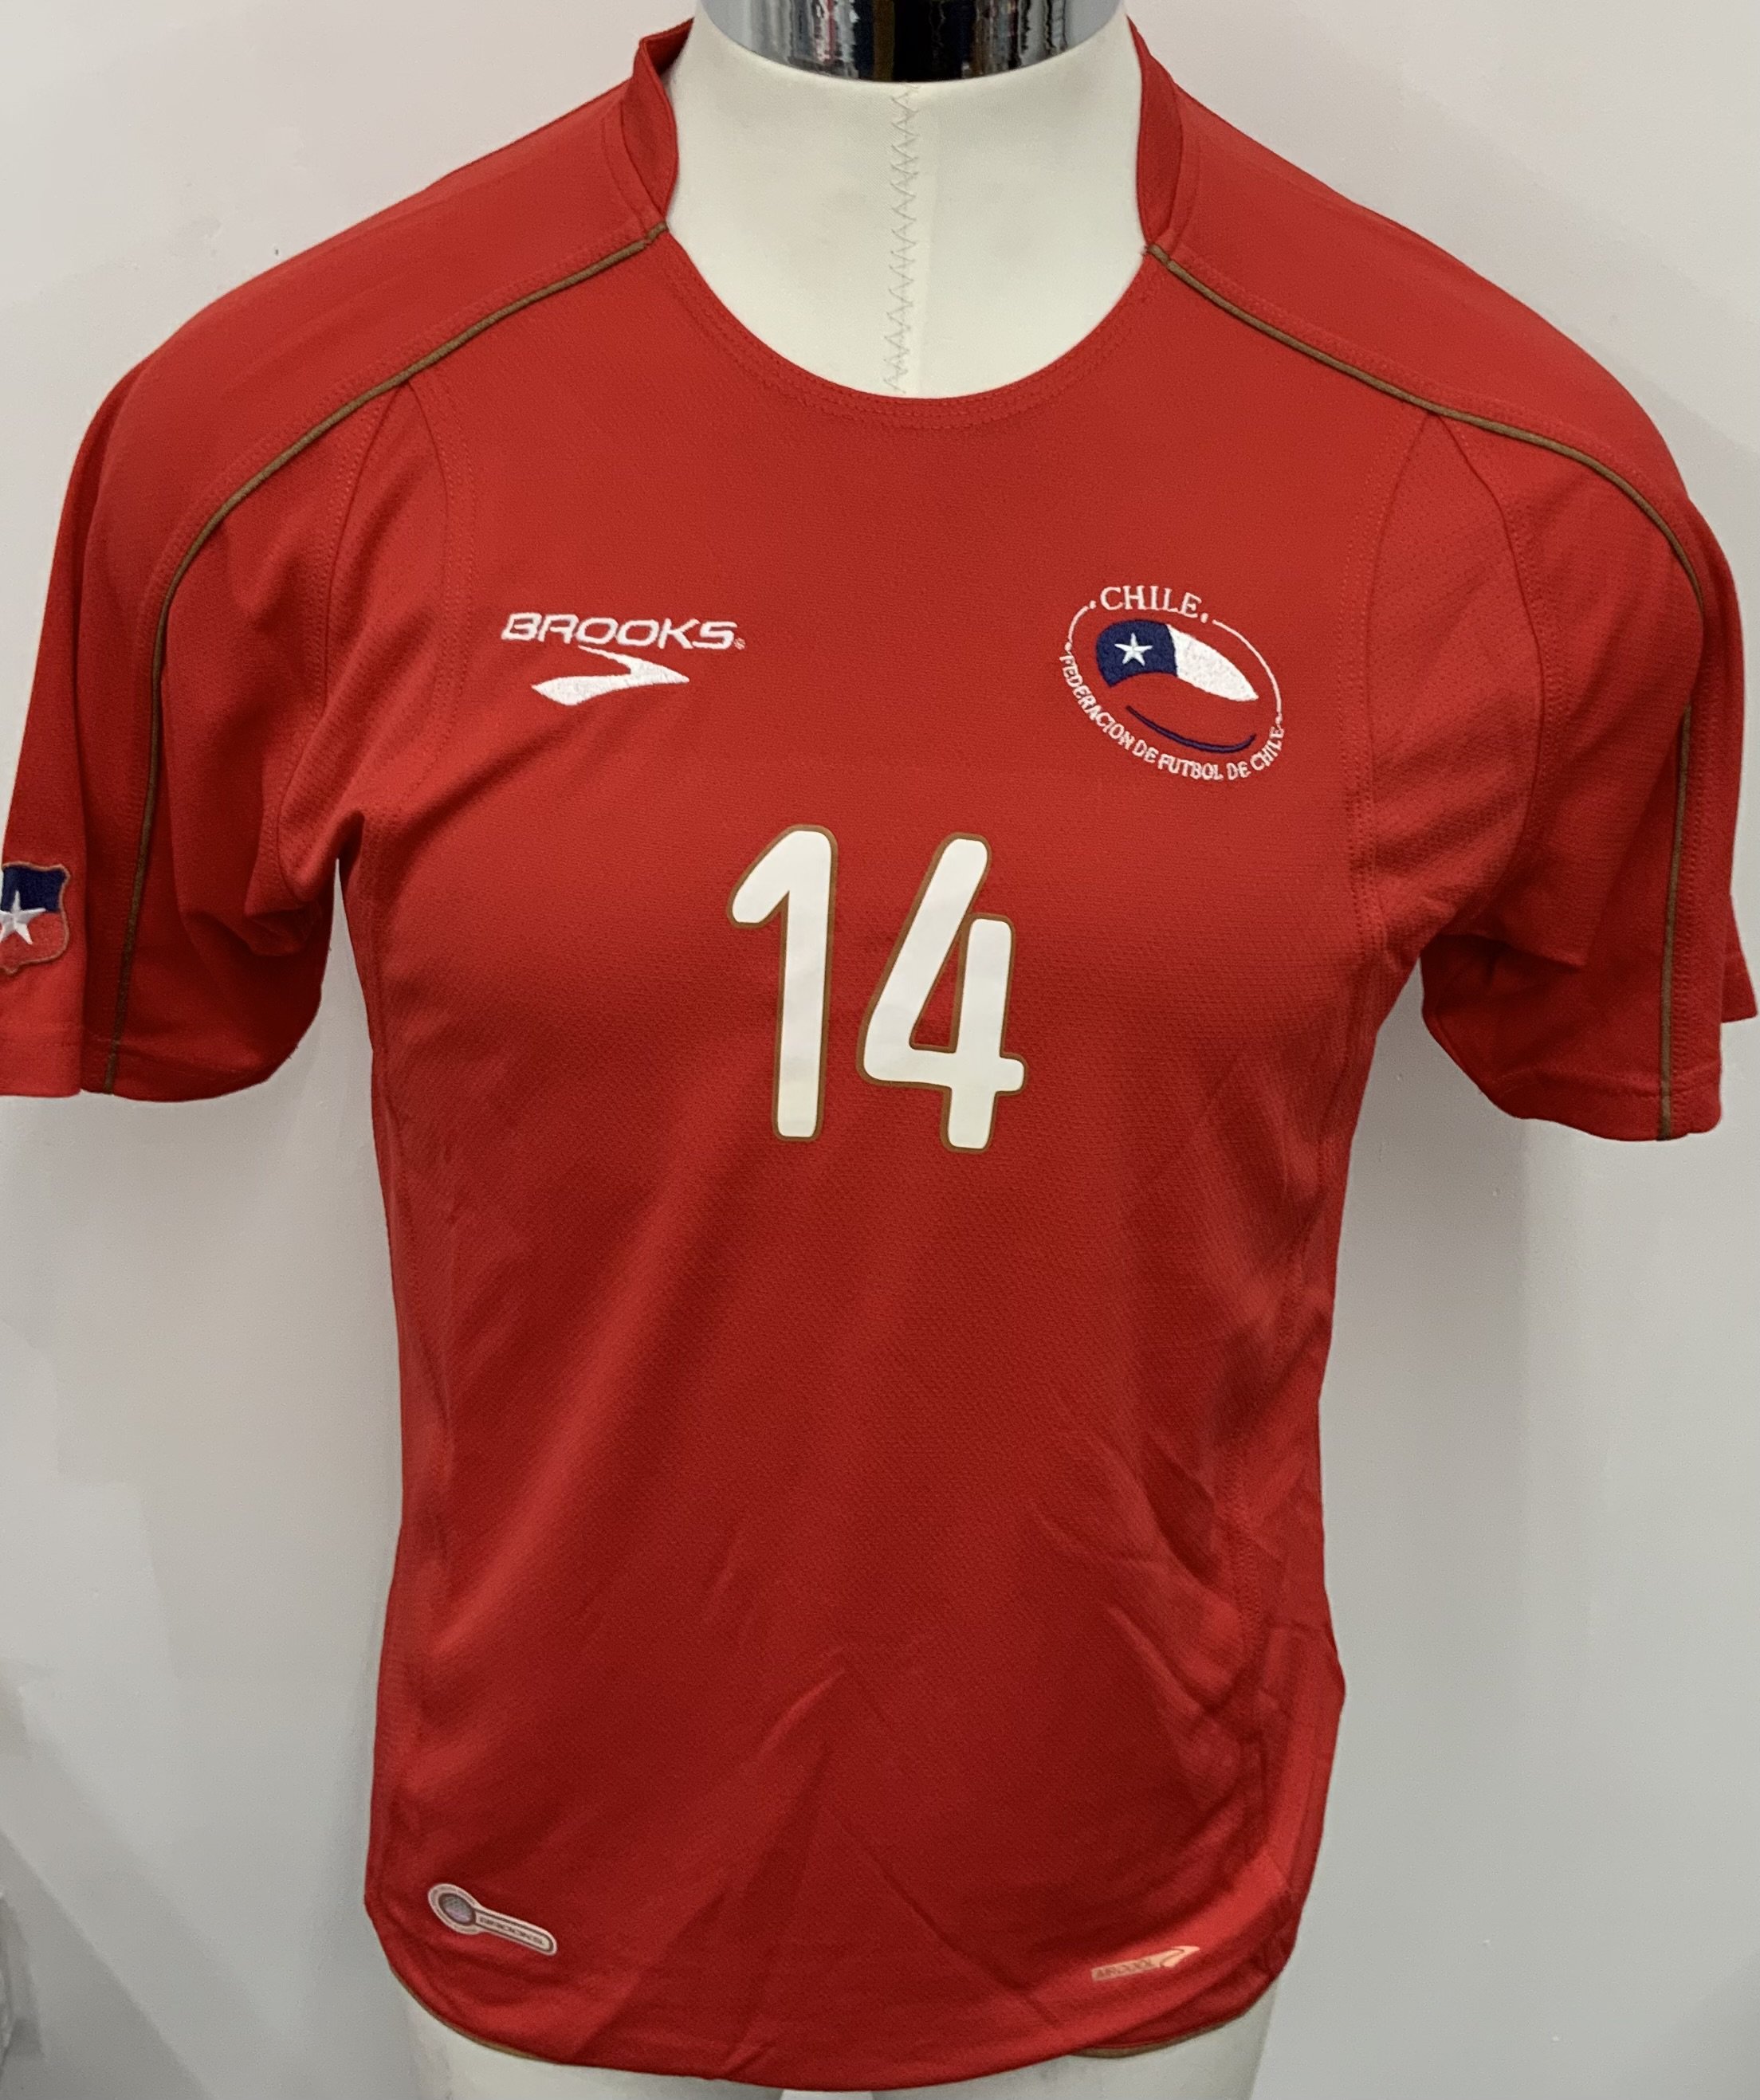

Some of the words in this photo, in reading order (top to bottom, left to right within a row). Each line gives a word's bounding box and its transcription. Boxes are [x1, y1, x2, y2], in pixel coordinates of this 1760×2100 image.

[501, 612, 737, 650] BROOKS
[1100, 585, 1201, 618] CHILE
[1059, 654, 1135, 750] FEDERACION
[1132, 740, 1159, 763] DE
[1157, 753, 1224, 780] FUTBOL
[1227, 762, 1251, 780] DE
[1250, 726, 1284, 771] CHILE
[729, 826, 1027, 1151] 14
